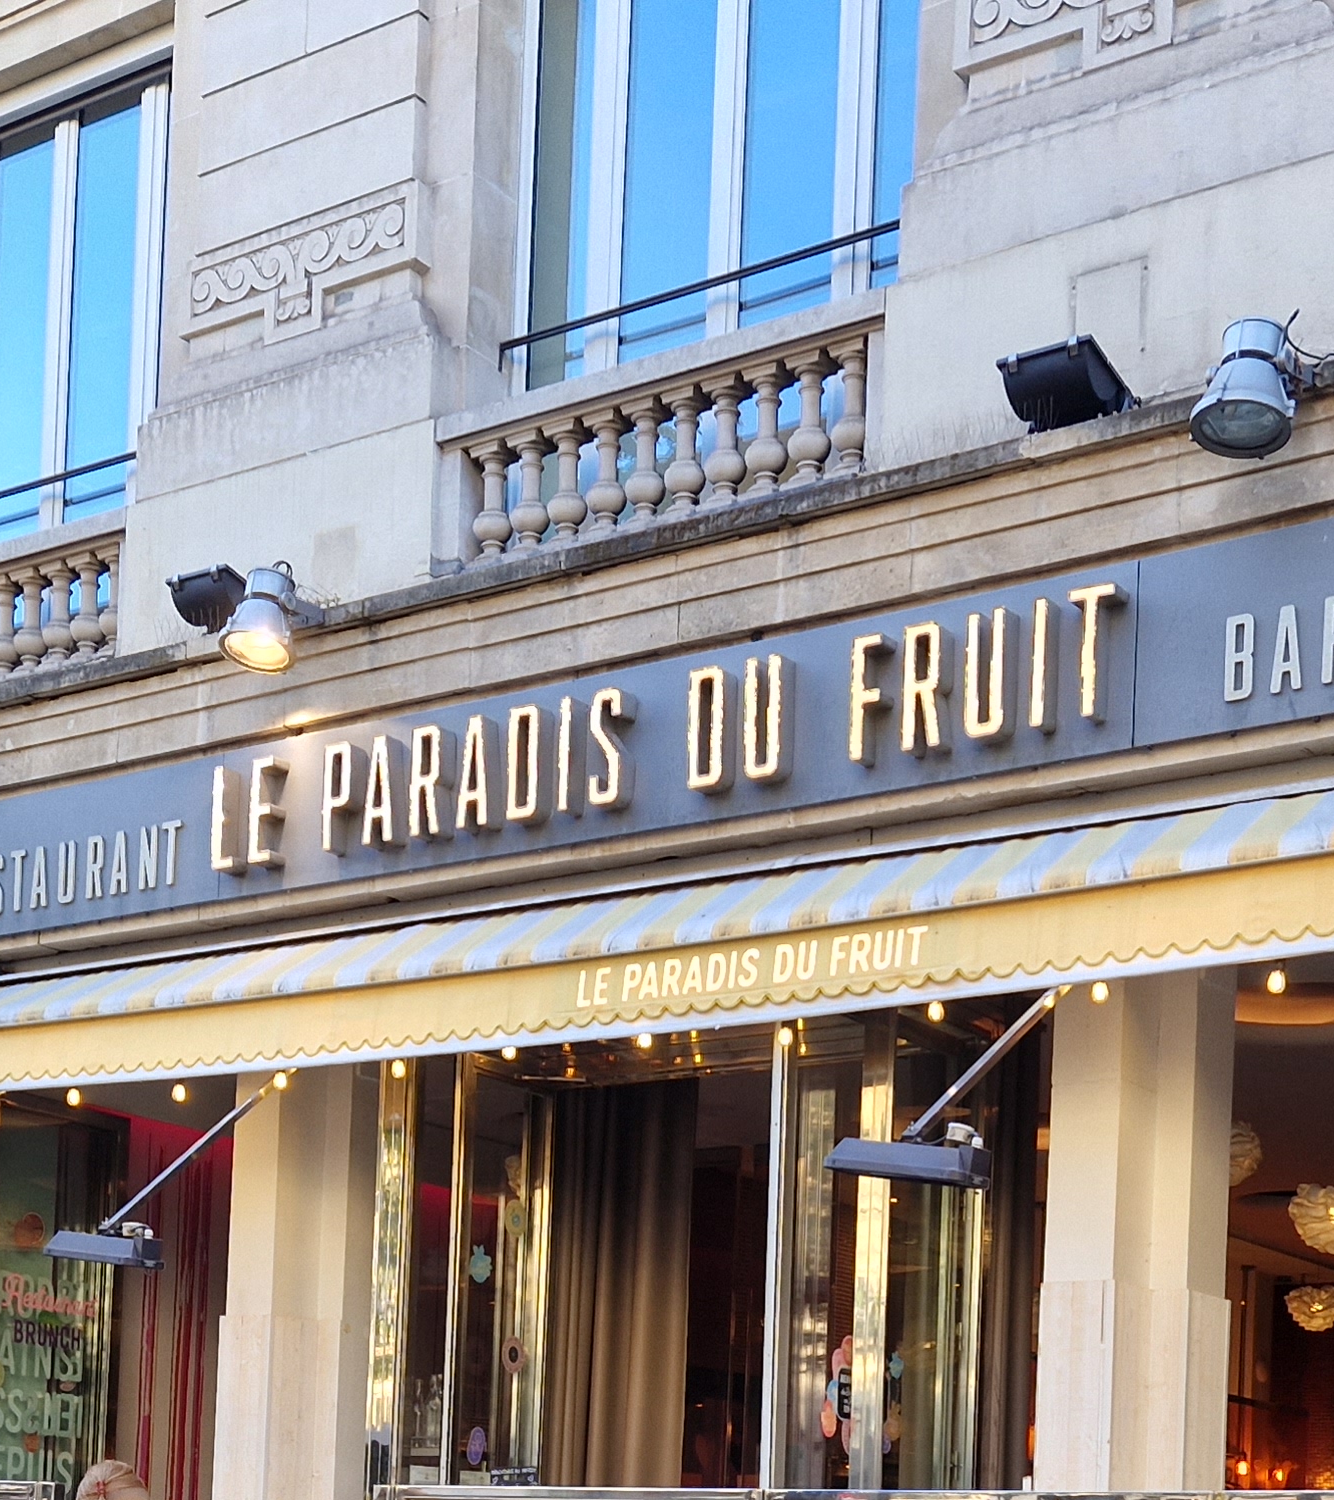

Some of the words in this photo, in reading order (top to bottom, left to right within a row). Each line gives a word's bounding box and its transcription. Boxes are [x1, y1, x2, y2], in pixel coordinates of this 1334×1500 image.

[210, 755, 289, 874] LE
[321, 687, 637, 857] PARADIS
[687, 654, 794, 793] DU
[849, 583, 1128, 767] FRUIT
[576, 967, 611, 1009] LE
[621, 947, 760, 1002] PARADIS
[773, 939, 818, 984] DU
[829, 925, 929, 977] FRUIT
[14, 1319, 82, 1350] BRUNCH
